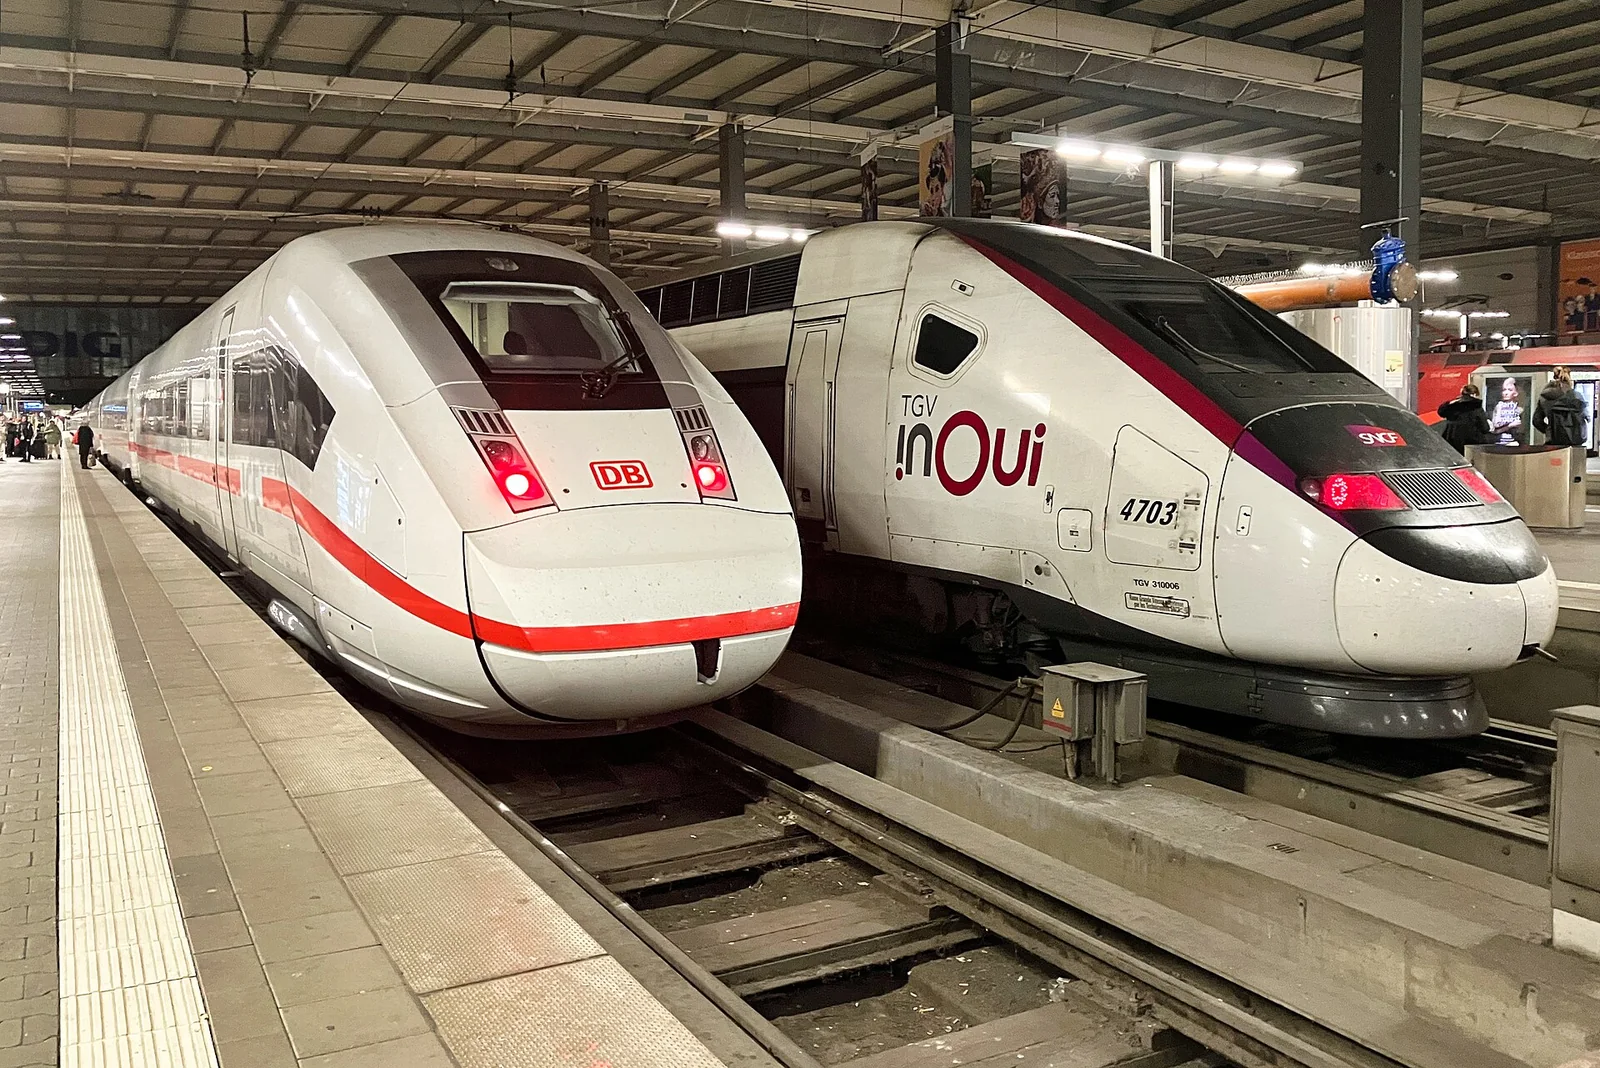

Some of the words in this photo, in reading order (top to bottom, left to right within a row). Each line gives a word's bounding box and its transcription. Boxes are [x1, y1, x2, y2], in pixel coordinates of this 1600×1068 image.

[901, 394, 938, 418] TGV
[1358, 432, 1398, 445] SNCF
[598, 464, 645, 486] DB
[1119, 498, 1178, 526] 4703
[1133, 578, 1150, 587] TGV
[1152, 580, 1180, 590] 310006
